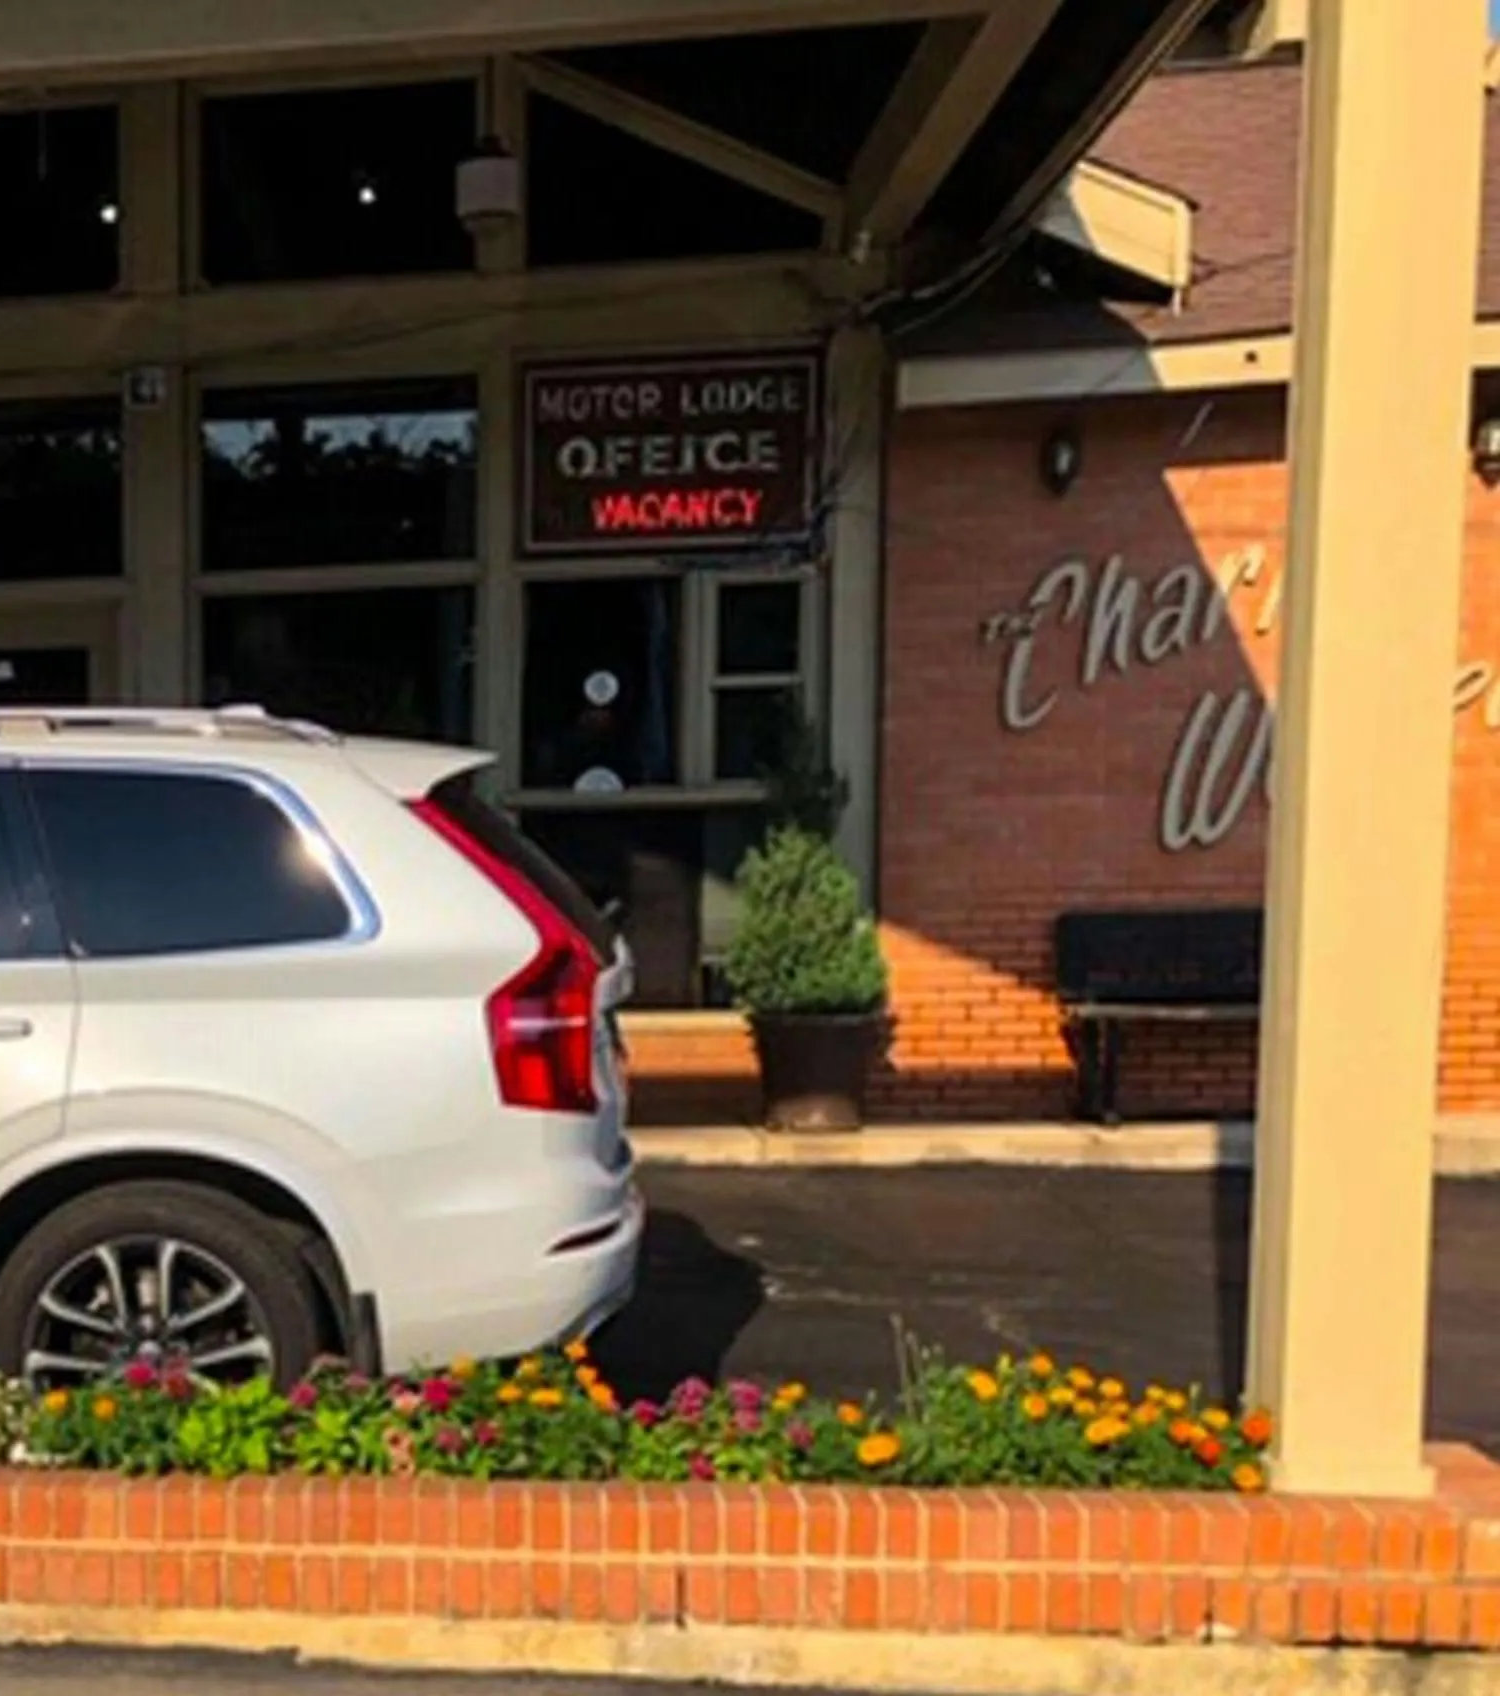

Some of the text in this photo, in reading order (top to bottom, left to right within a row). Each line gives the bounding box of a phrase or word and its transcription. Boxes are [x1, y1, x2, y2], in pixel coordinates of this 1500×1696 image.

[538, 375, 801, 422] MOTOR LODGE
[591, 487, 762, 531] VACANCY
